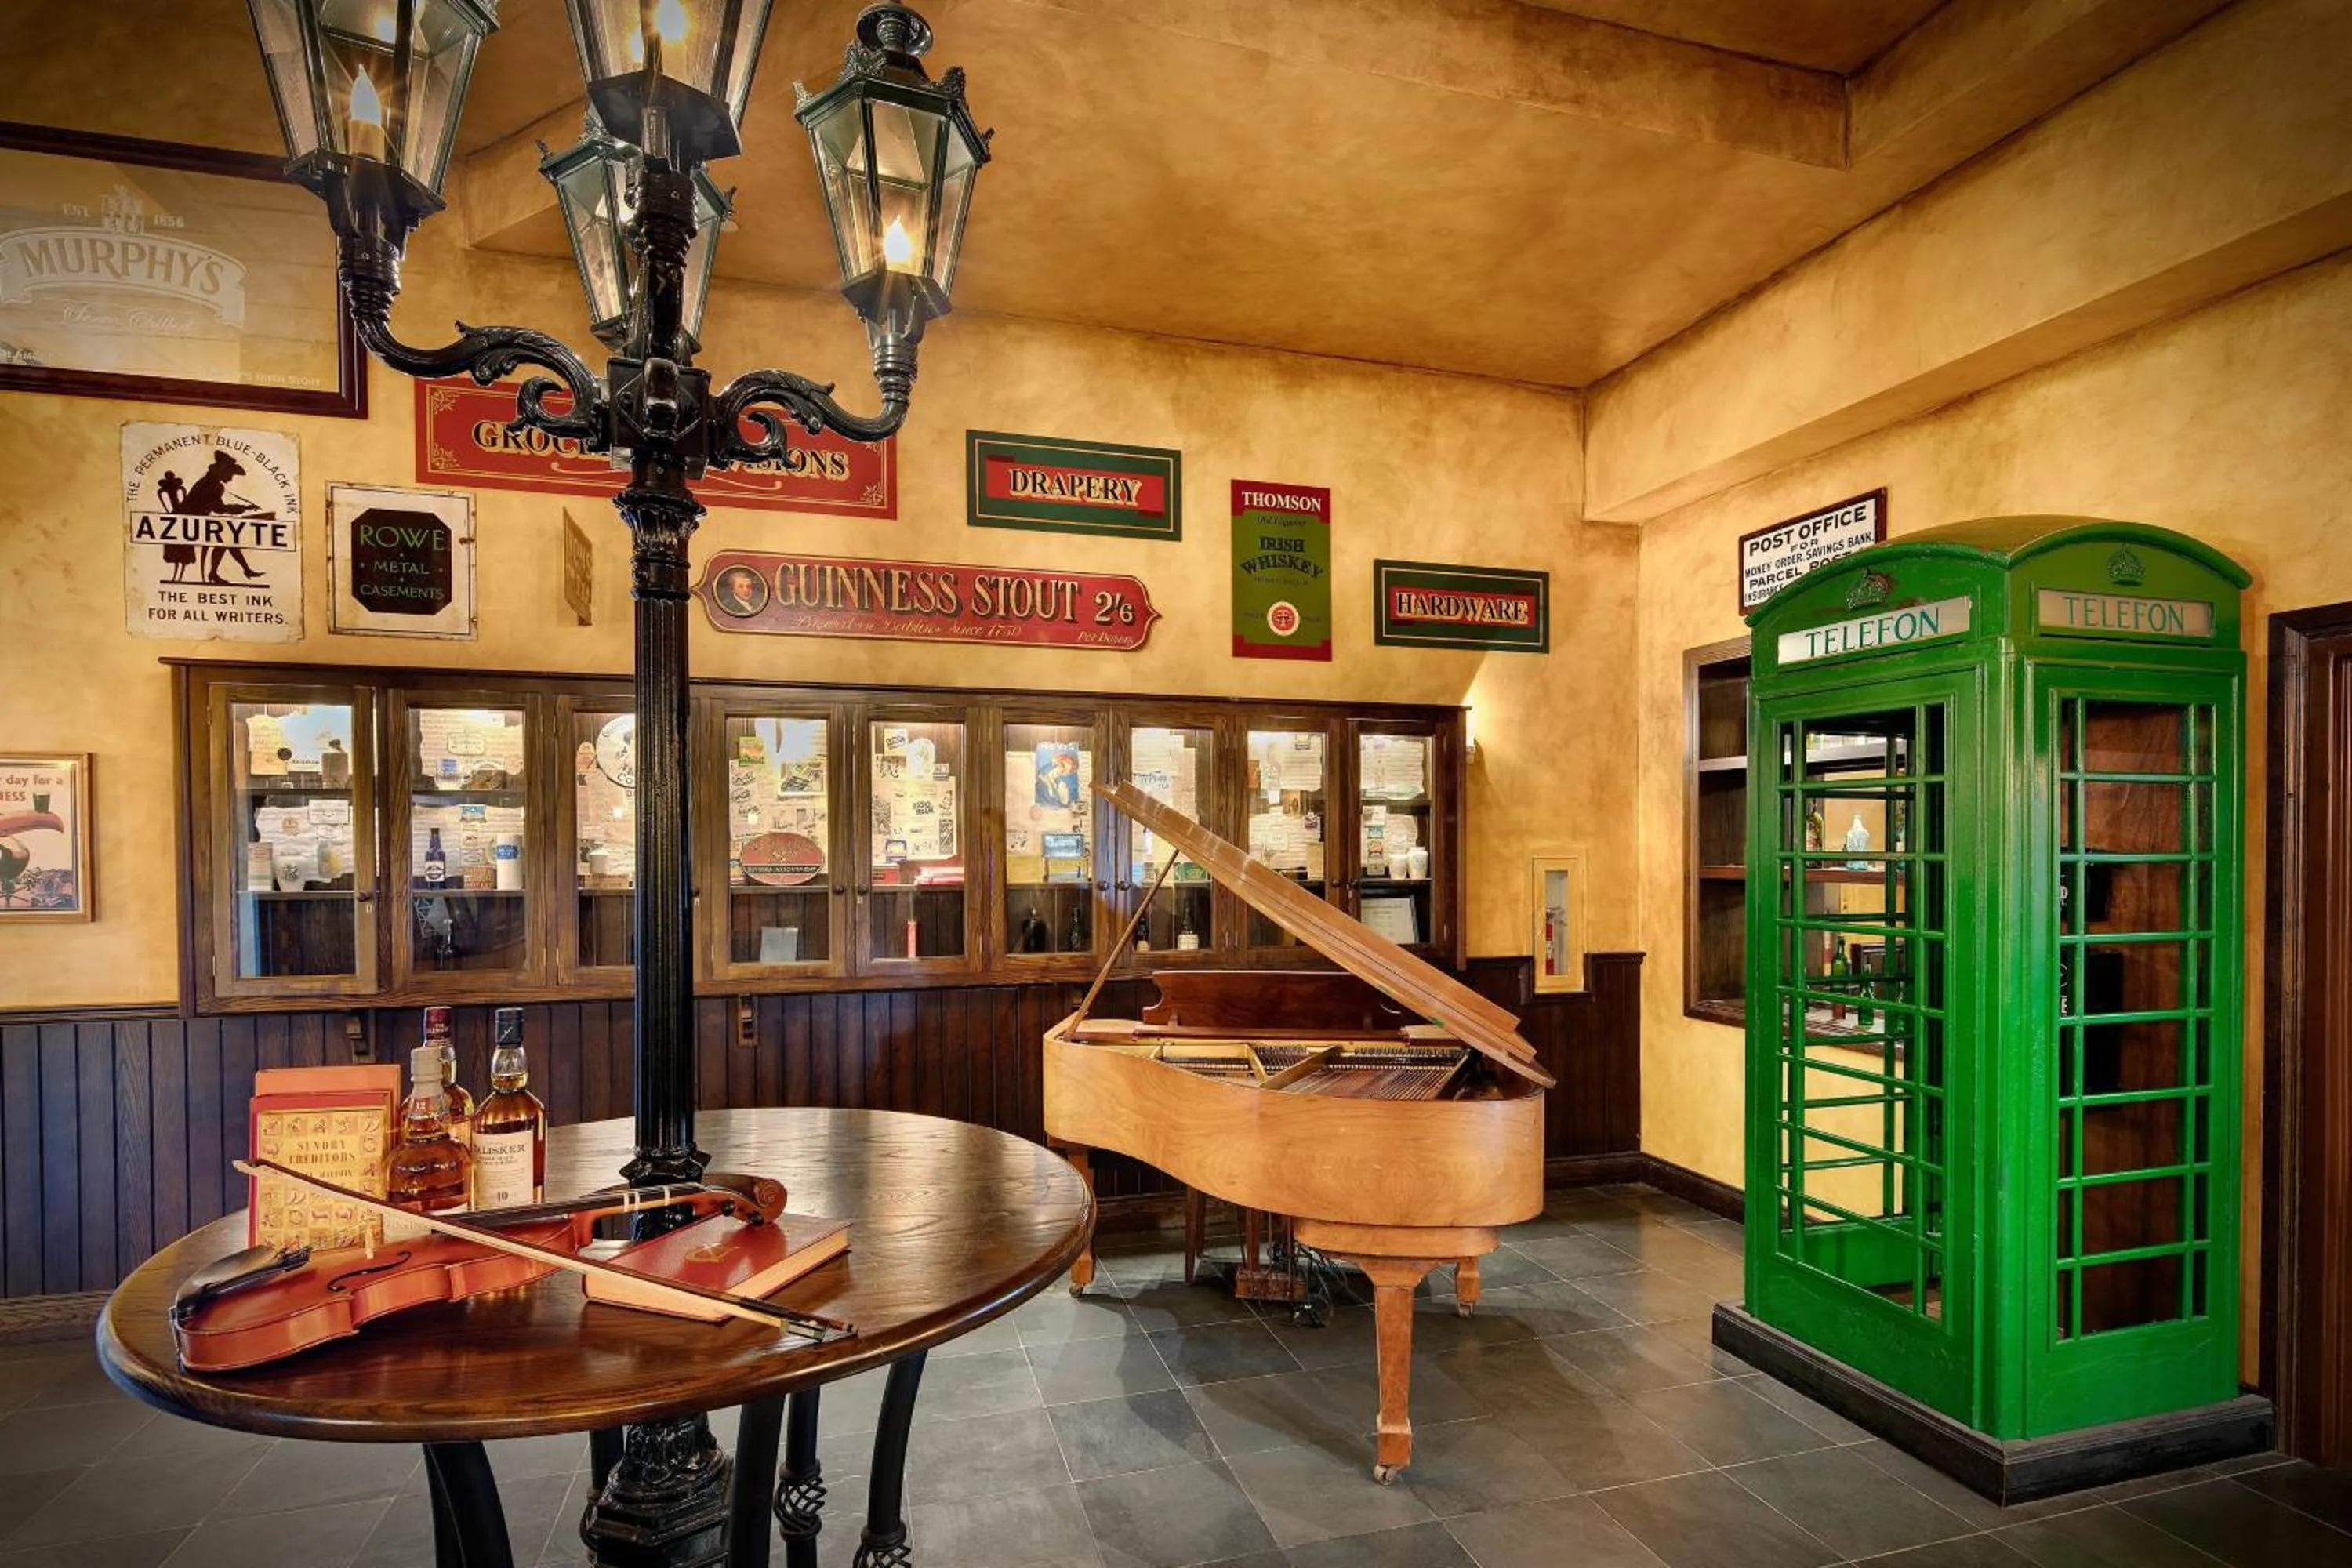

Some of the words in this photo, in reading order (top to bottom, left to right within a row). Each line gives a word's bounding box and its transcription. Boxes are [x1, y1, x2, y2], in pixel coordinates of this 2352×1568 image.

[17, 238, 224, 295] MURPHY'S
[126, 481, 140, 502] THE
[135, 434, 212, 476] PERMANENT
[216, 436, 291, 488] BLUE-BLACK
[284, 493, 298, 514] INK
[1009, 467, 1142, 506] DRAPERY
[1241, 491, 1322, 513] THOMSON
[136, 515, 288, 548] AZURYTE
[360, 524, 445, 551] ROWE
[1749, 529, 1794, 557] POST
[1798, 505, 1867, 539] OFFICE
[1259, 535, 1305, 552] IRISH
[1791, 539, 1819, 553] FOR
[373, 560, 430, 575] METAL
[1240, 554, 1324, 579] WHISKEY
[1744, 564, 1771, 579] MONEY
[1806, 540, 1844, 561] SAVINGS
[1749, 568, 1802, 590] PARCEL
[158, 590, 188, 603] THE
[198, 592, 238, 606] BEST
[246, 595, 274, 608] INK
[360, 584, 445, 600] CASEMENTS
[774, 562, 961, 615] GUINNESS
[971, 574, 1080, 621] STOUT
[148, 608, 176, 620] FOR
[183, 609, 209, 622] ALL
[215, 611, 289, 625] WRITERS.
[1395, 591, 1529, 625] HARDWARE
[2062, 596, 2184, 633] TELEFON
[1804, 606, 1940, 658] TELEFON
[5, 774, 29, 787] day
[33, 774, 52, 785] for
[297, 1139, 346, 1151] SUNDRY
[289, 1152, 356, 1164] CREDITORS
[497, 1190, 509, 1203] 10
